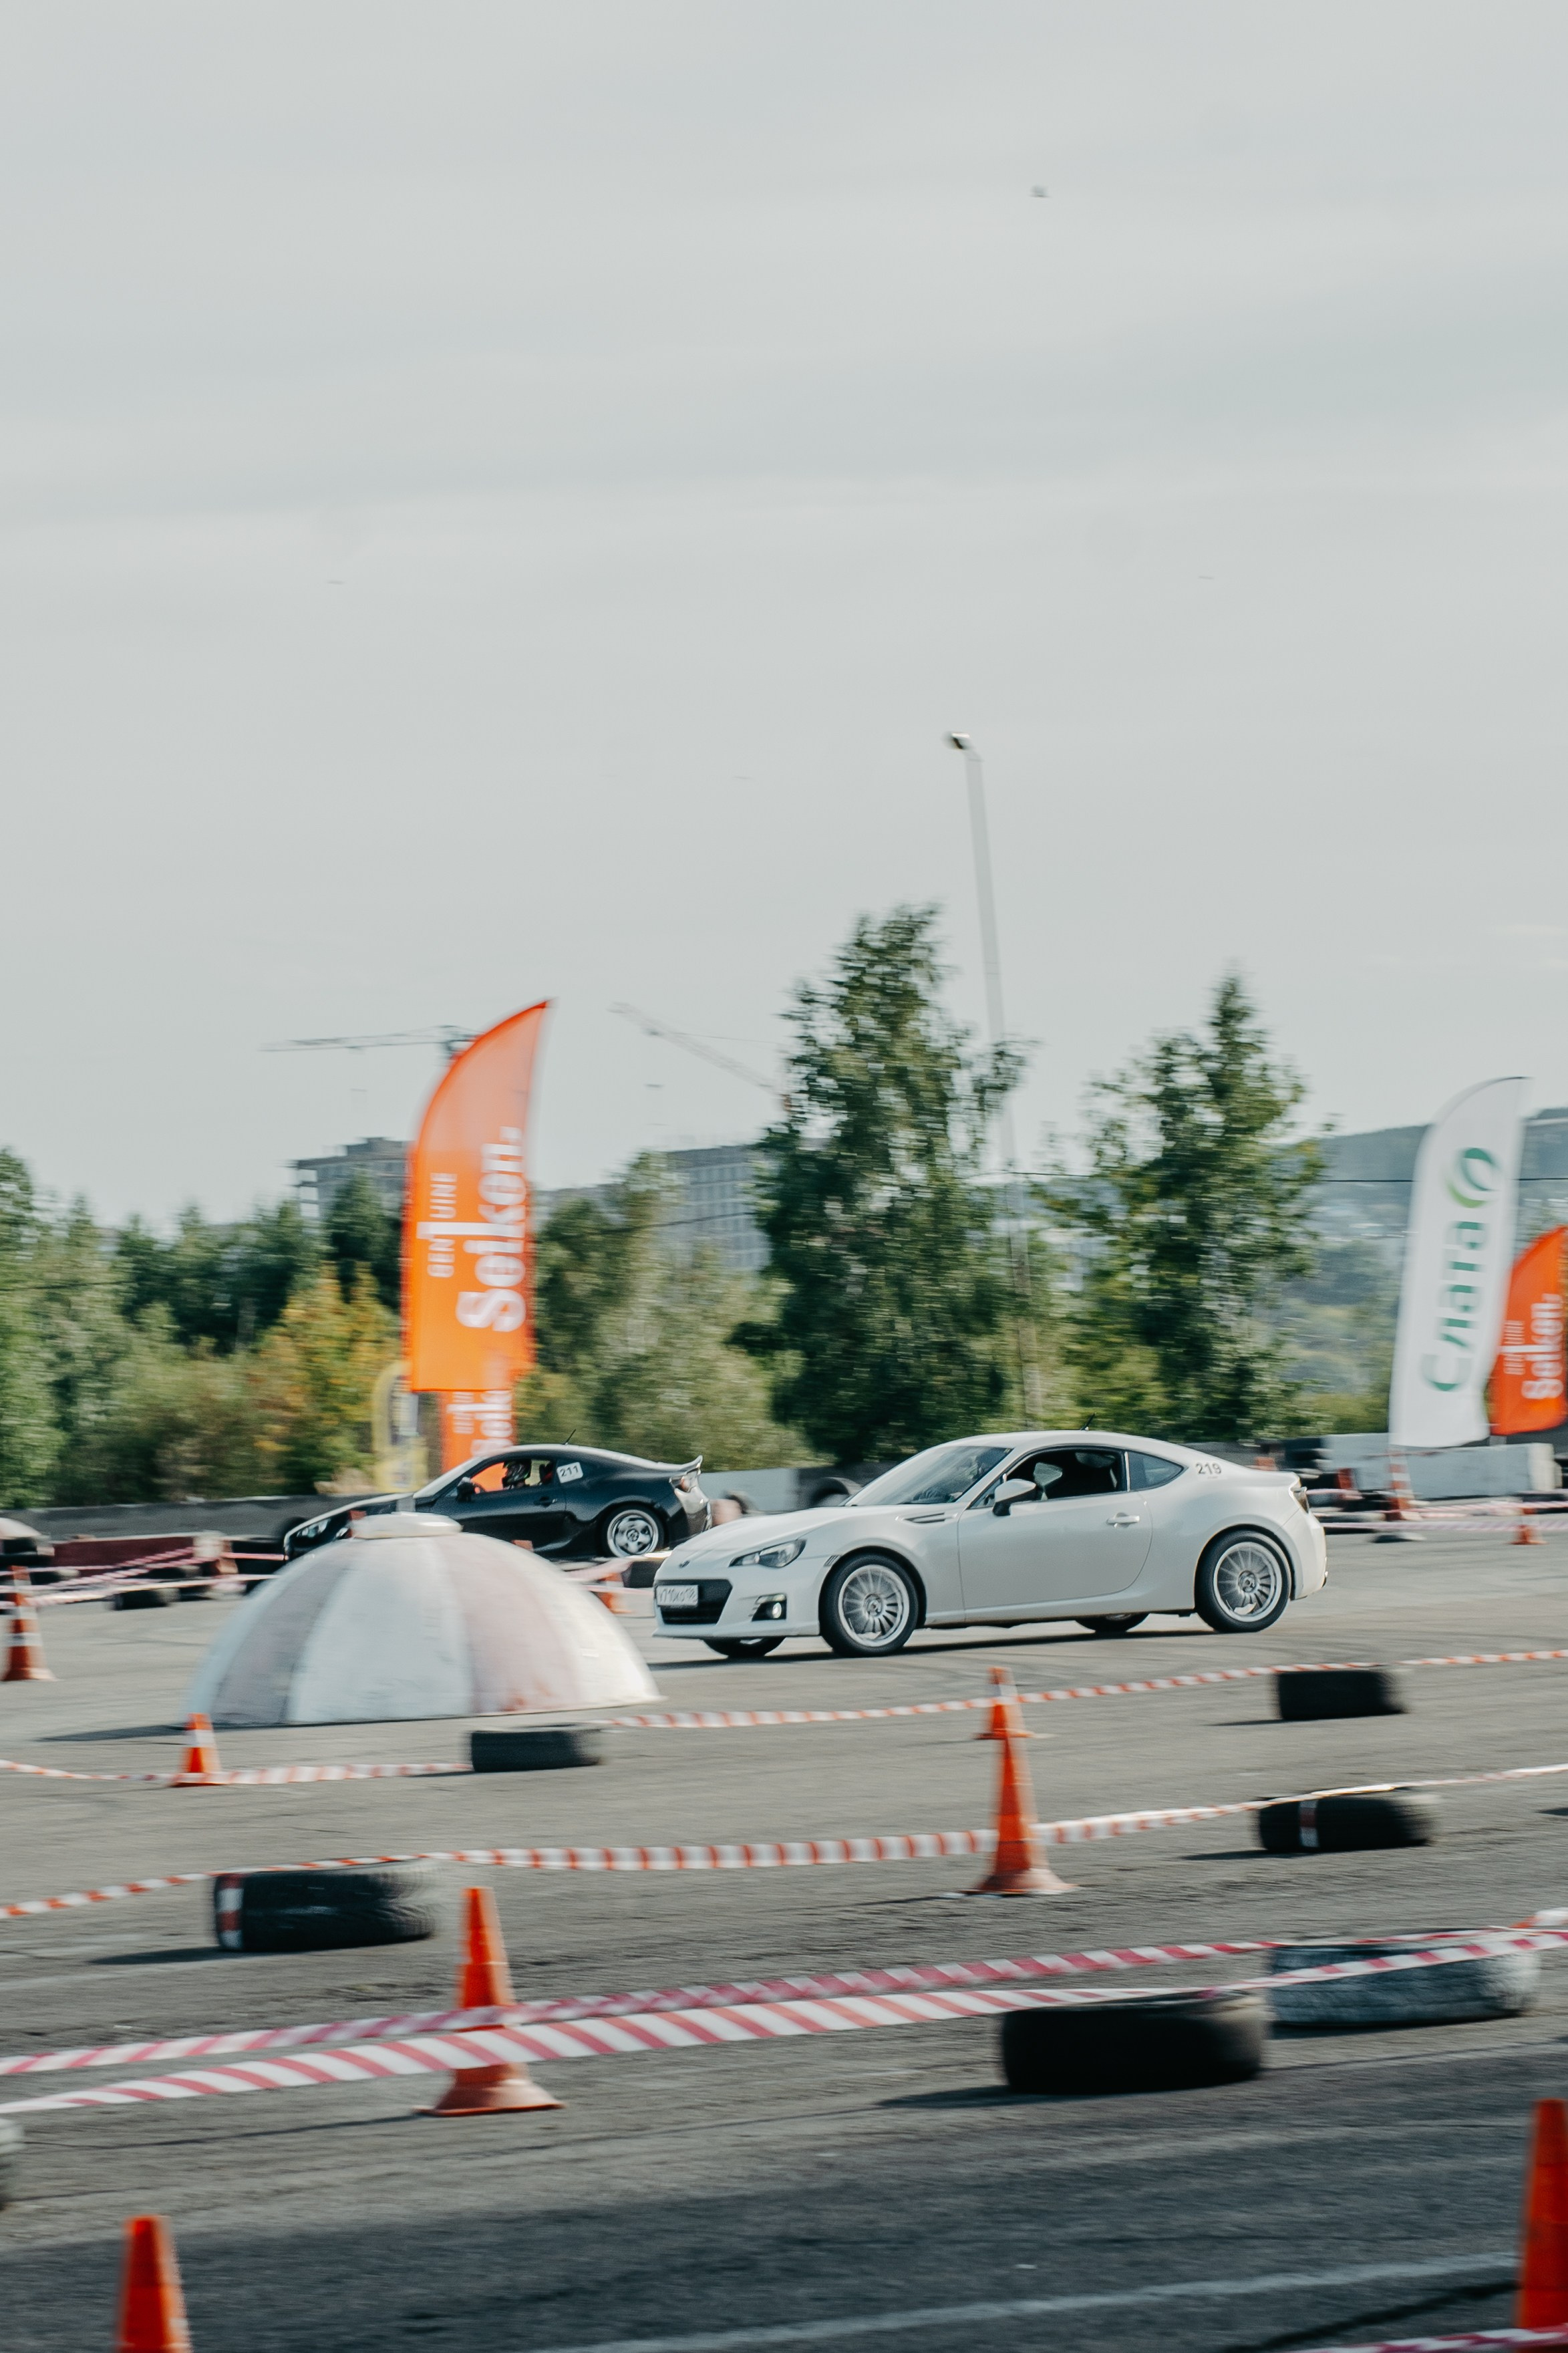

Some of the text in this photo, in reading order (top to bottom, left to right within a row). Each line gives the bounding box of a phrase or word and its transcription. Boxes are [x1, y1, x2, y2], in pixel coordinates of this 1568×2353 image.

[427, 1172, 458, 1278] GENUINE
[560, 1465, 579, 1477] 211
[1195, 1462, 1221, 1475] 219
